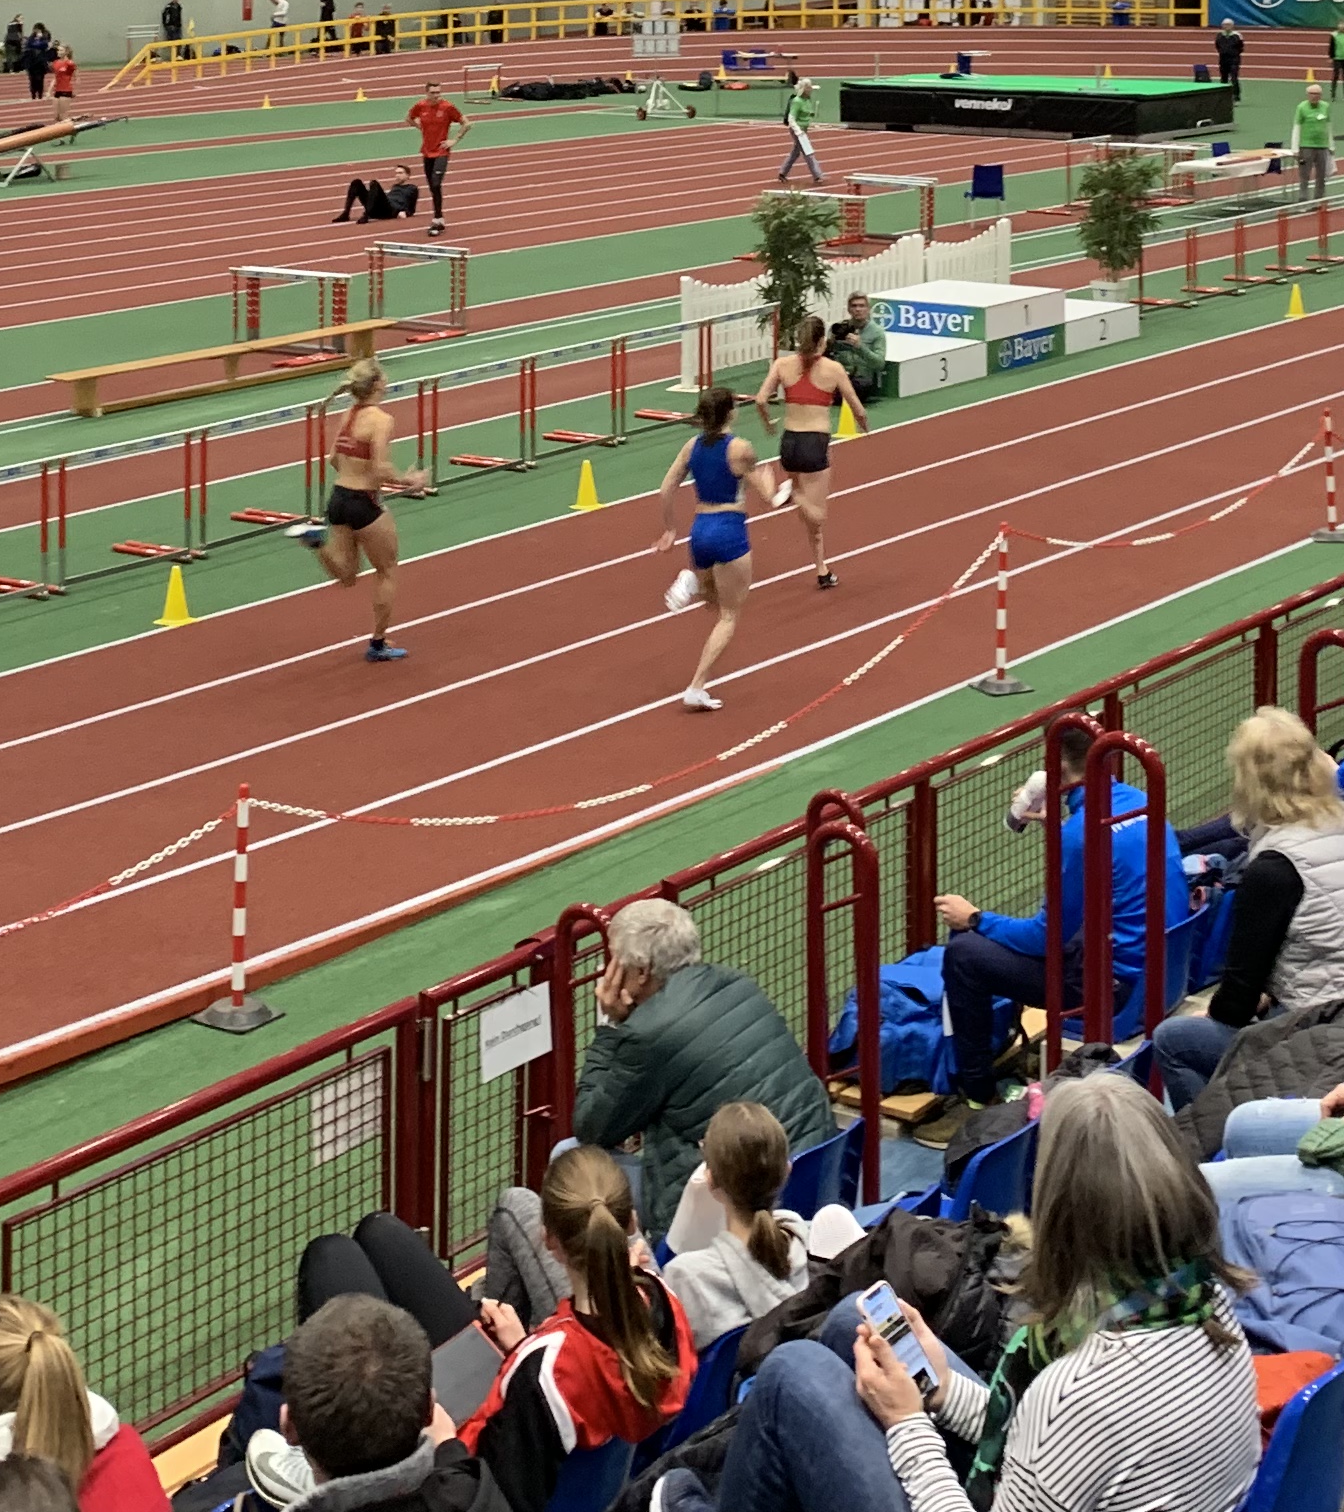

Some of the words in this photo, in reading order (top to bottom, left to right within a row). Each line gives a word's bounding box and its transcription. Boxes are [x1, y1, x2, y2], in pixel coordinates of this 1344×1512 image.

[897, 303, 975, 335] Bayer
[1023, 304, 1031, 326] 1
[1098, 318, 1108, 341] 2
[1013, 334, 1055, 360] Bayer
[939, 356, 949, 382] 3
